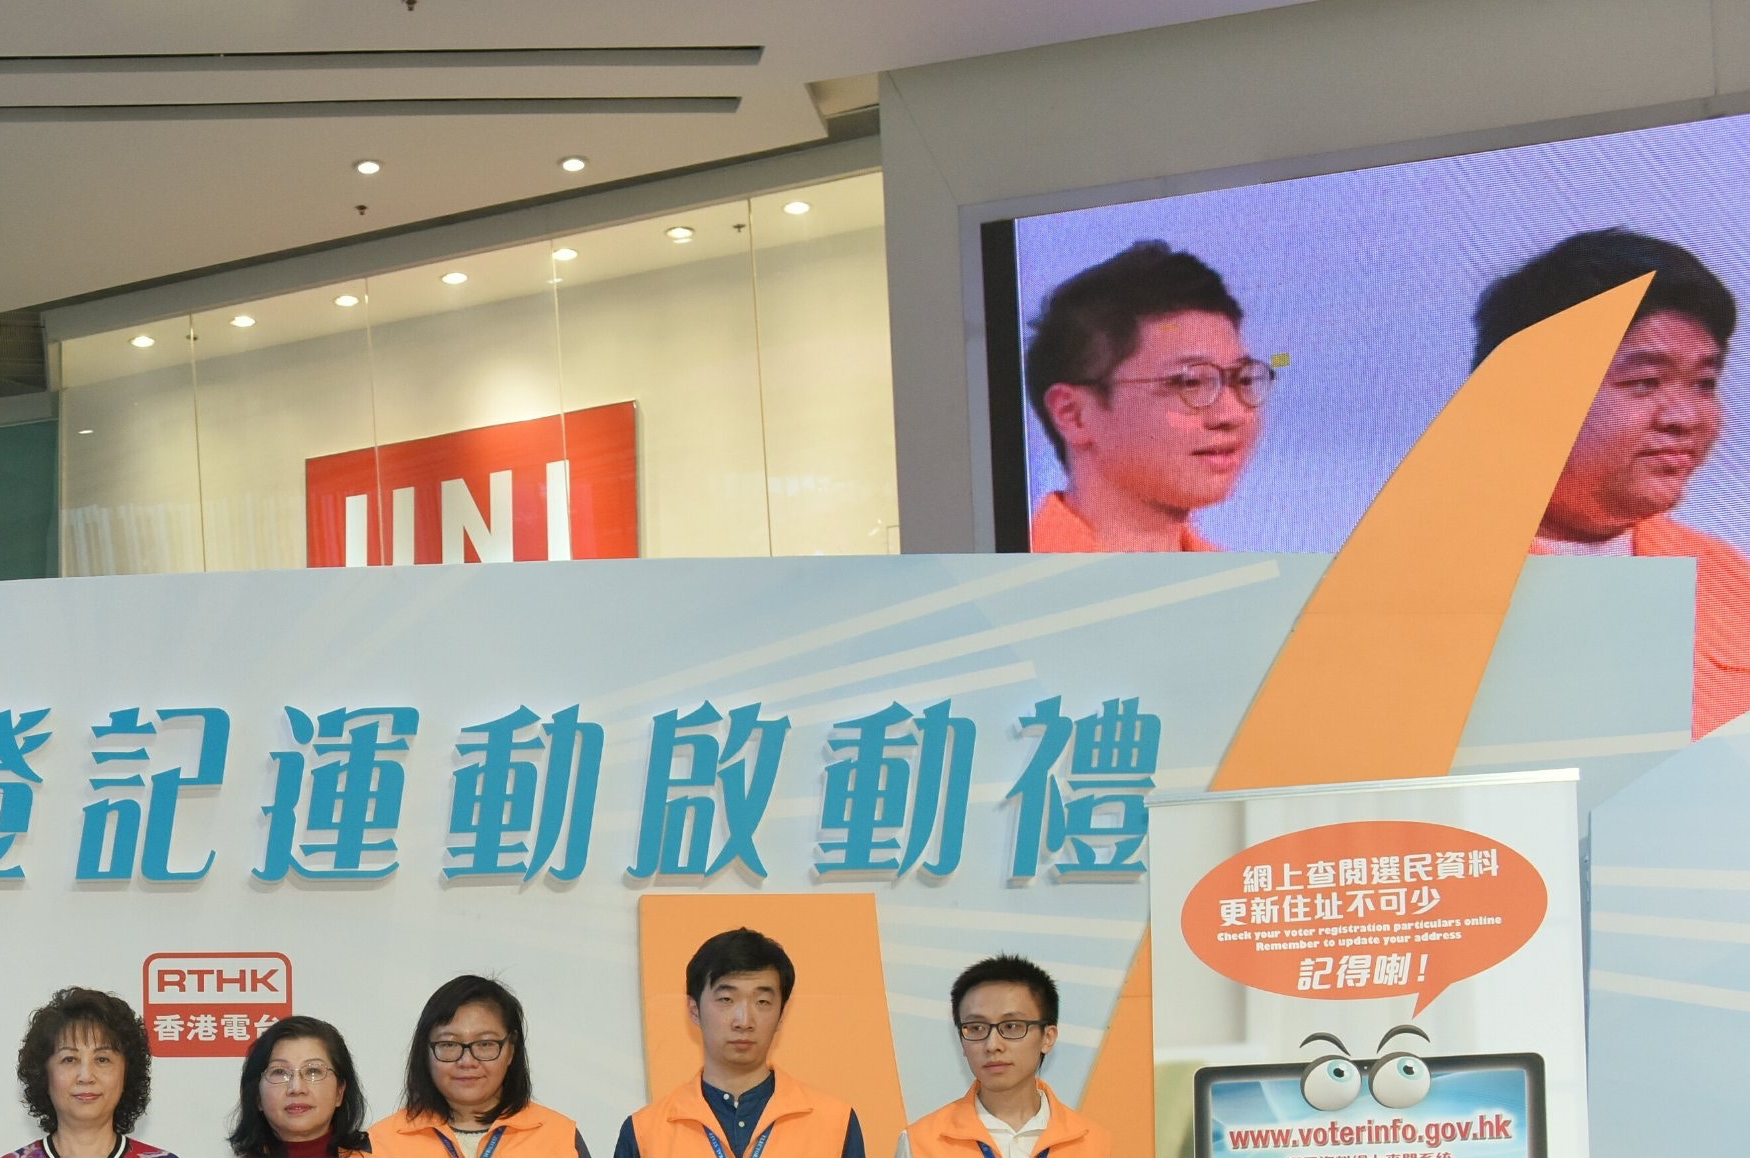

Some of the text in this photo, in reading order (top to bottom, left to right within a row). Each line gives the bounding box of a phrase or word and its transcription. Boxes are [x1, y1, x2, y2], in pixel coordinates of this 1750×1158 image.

[1242, 848, 1500, 894] 網上查閱選民資料
[1219, 886, 1442, 927] 更新住址不可少
[1217, 916, 1502, 944] Check your voter registration particulars online
[1255, 931, 1462, 952] Remember to update your address
[157, 969, 279, 992] RTHK
[1229, 1114, 1512, 1149] www.voterinfo.gov.hk
